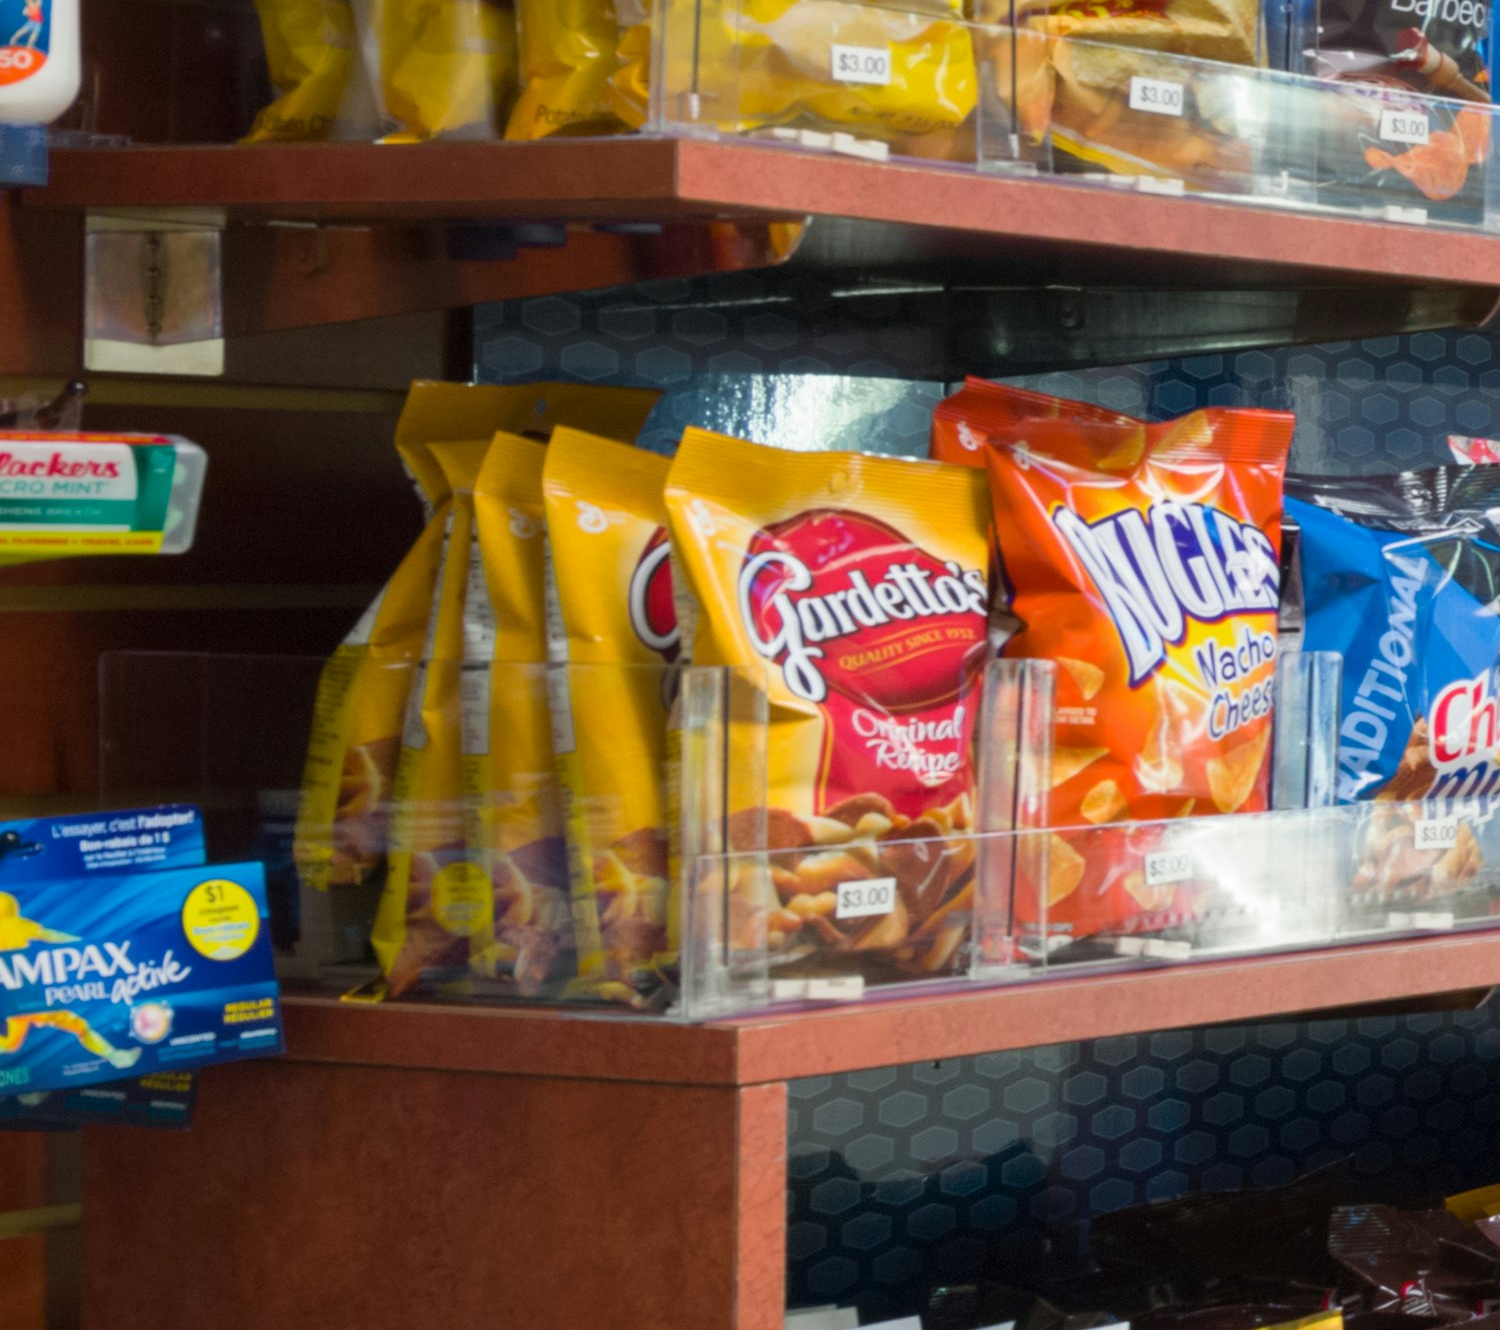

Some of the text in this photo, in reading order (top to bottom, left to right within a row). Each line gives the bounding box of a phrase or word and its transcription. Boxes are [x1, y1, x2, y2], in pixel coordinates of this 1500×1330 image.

[838, 51, 886, 75] $3.00
[1140, 84, 1181, 108] $3.00
[1391, 119, 1426, 137] $3.00
[0, 453, 120, 478] lackers
[738, 551, 989, 702] Gardetto's
[1197, 629, 1275, 688] Nacho
[852, 706, 965, 741] Original
[1422, 826, 1454, 842] $3.00
[206, 885, 226, 903] $1
[842, 888, 890, 908] $3.00
[0, 940, 134, 990] AMPAX
